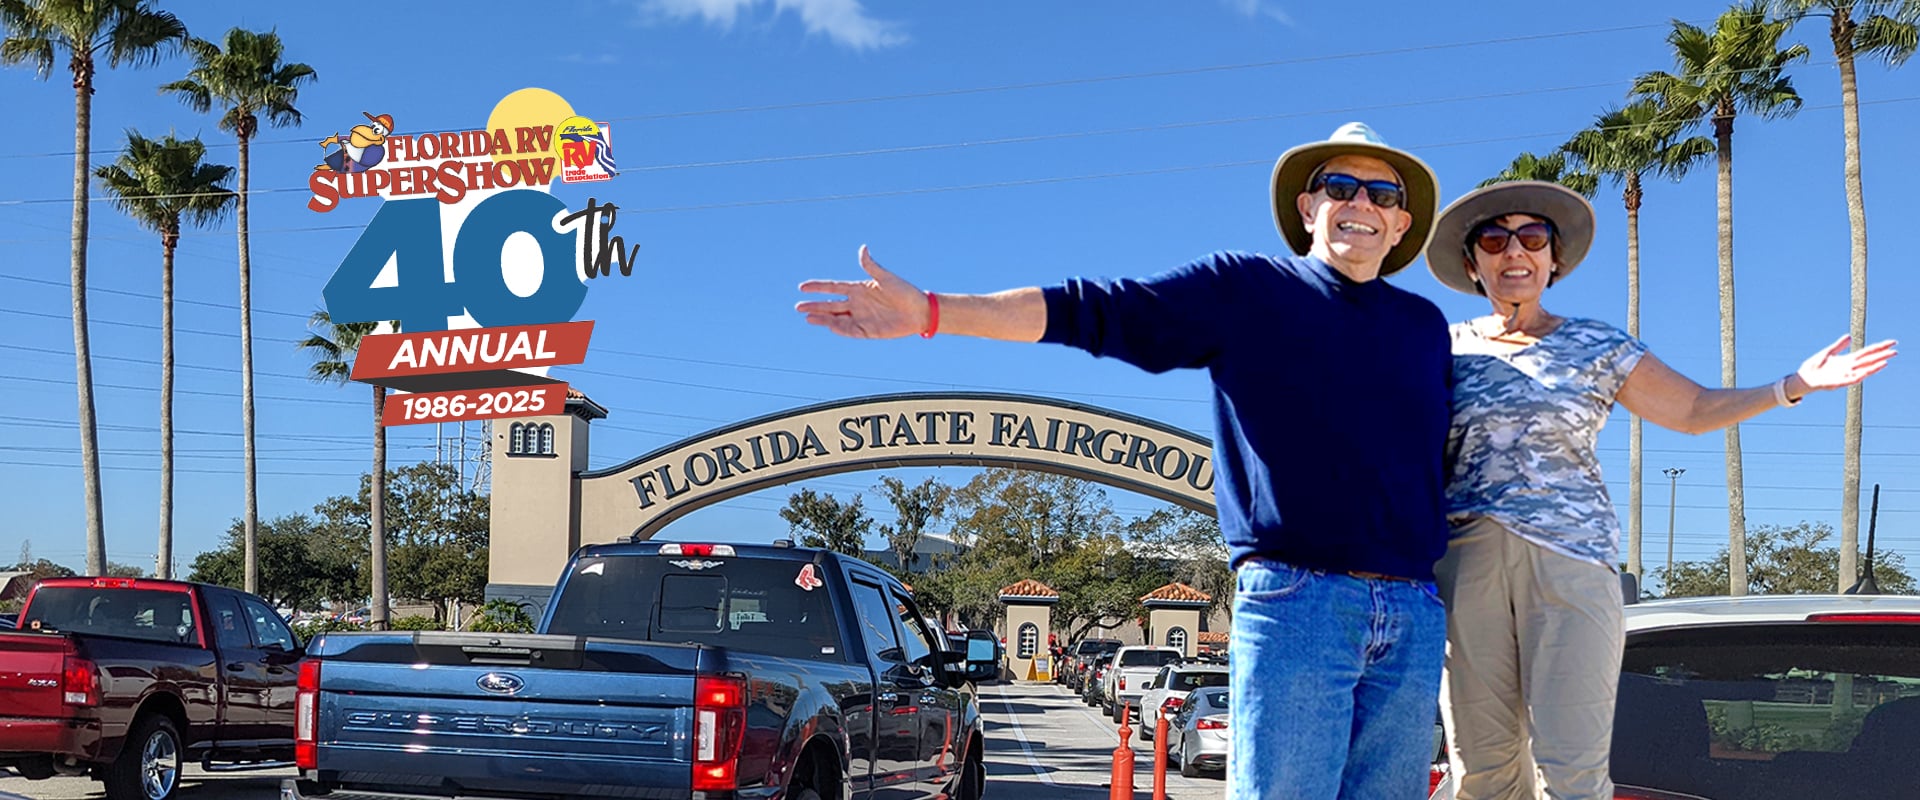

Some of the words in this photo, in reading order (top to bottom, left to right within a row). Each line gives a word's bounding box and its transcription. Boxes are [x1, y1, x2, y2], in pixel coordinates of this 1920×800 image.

[628, 424, 828, 510] FLORIDA
[839, 411, 976, 453] STATE
[988, 411, 1215, 495] FAIRGROU
